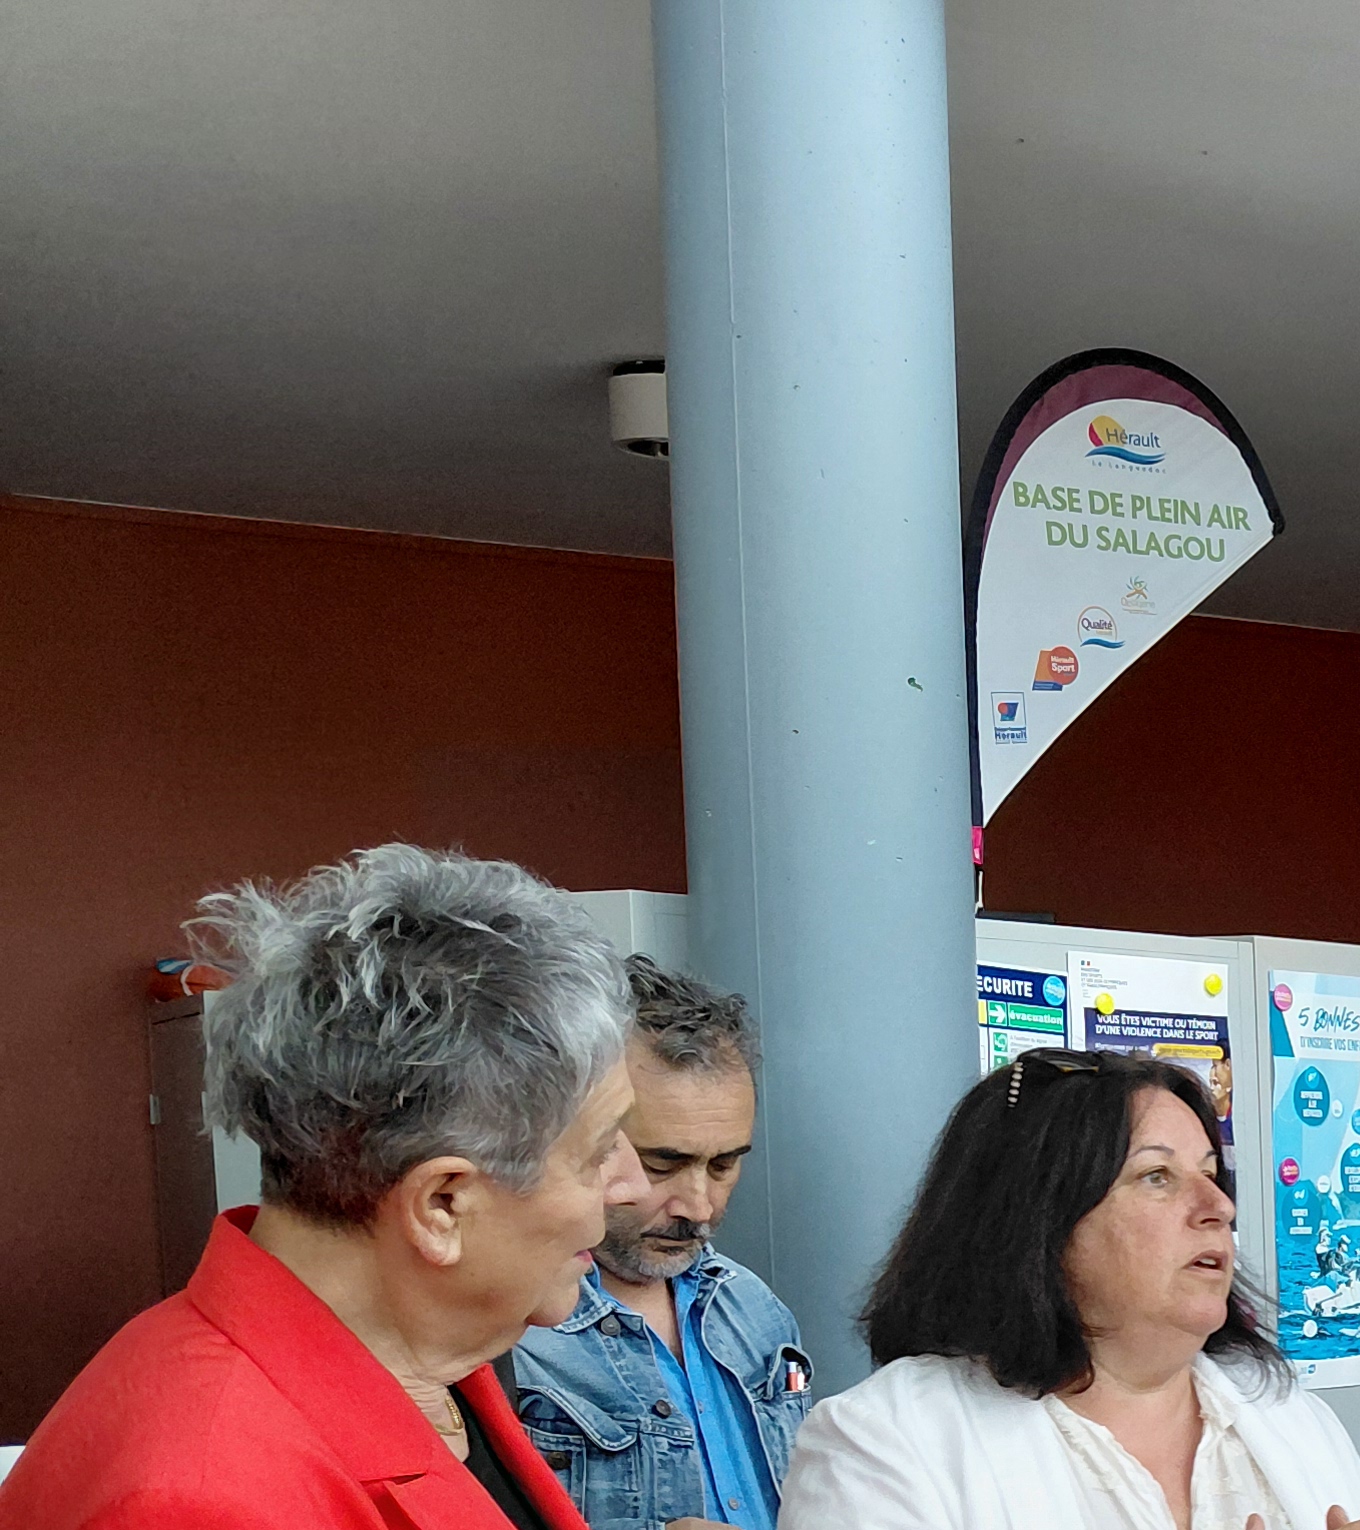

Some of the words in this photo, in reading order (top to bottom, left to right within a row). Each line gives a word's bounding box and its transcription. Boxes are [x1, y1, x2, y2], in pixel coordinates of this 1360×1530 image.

[1105, 428, 1161, 448] Hérault
[1013, 481, 1083, 514] BASE
[1088, 489, 1125, 519] DE
[1130, 494, 1201, 526] PLEIN
[1206, 503, 1252, 531] AIR
[1045, 520, 1089, 549] DU
[1096, 526, 1226, 562] SALAGOU
[1081, 617, 1113, 631] Qualité
[1051, 662, 1075, 673] Sport
[1009, 1009, 1063, 1025] évacuation
[1121, 1013, 1139, 1026] ÊTES
[1140, 1016, 1174, 1028] VICTIME
[1175, 1019, 1186, 1029] OU
[1298, 1007, 1310, 1027] 5
[1095, 1024, 1121, 1035] D'UNE
[1121, 1026, 1161, 1038] VIOLENCE
[1163, 1029, 1184, 1039] DANS
[1186, 1031, 1195, 1039] LE
[1195, 1031, 1218, 1040] SPORT
